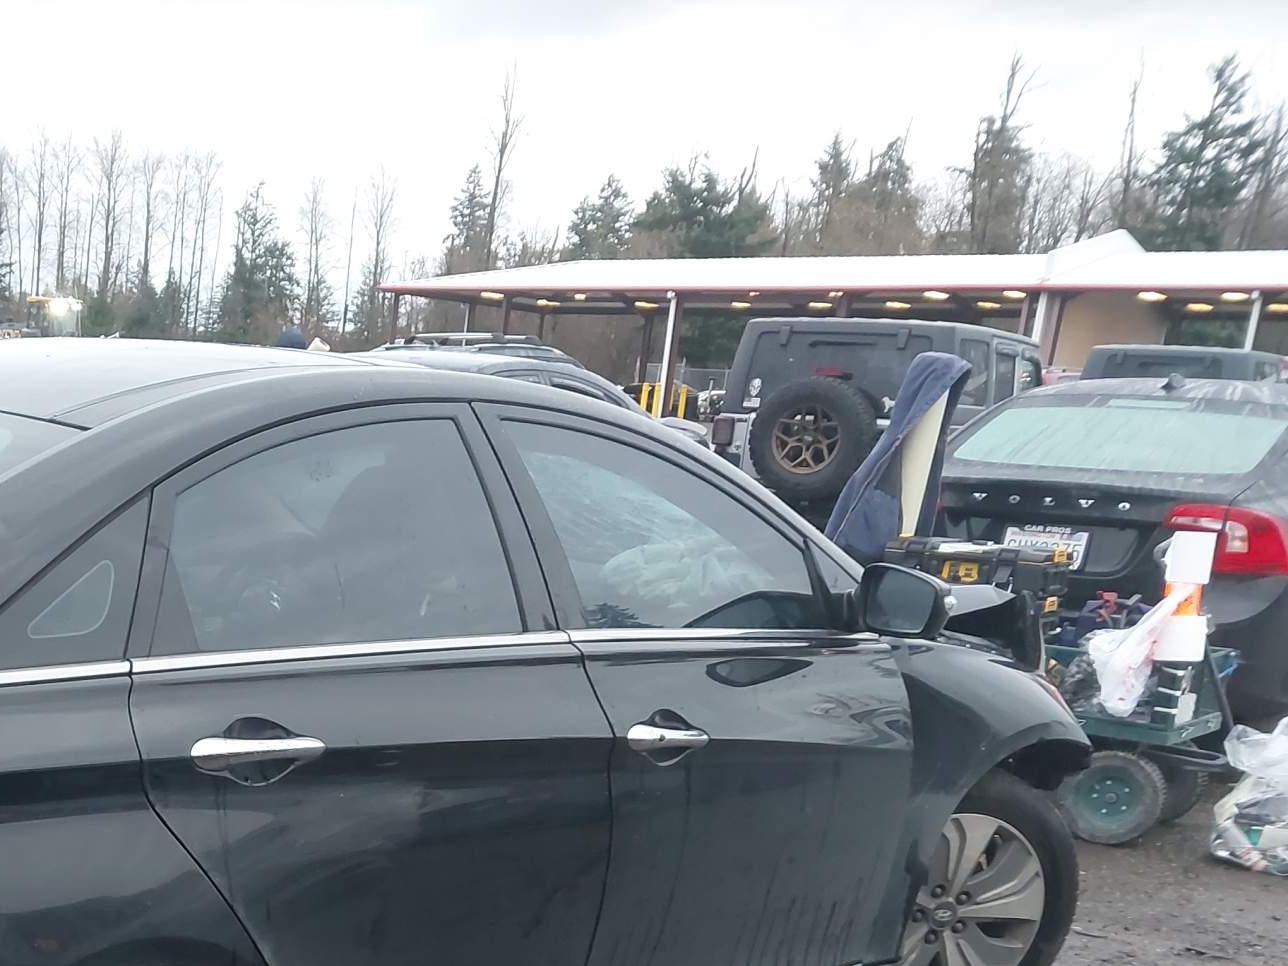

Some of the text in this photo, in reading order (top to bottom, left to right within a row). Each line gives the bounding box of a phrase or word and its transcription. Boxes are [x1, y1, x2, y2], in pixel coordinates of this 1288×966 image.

[972, 492, 1131, 511] VOLVO
[1024, 524, 1072, 534] CAR PROS
